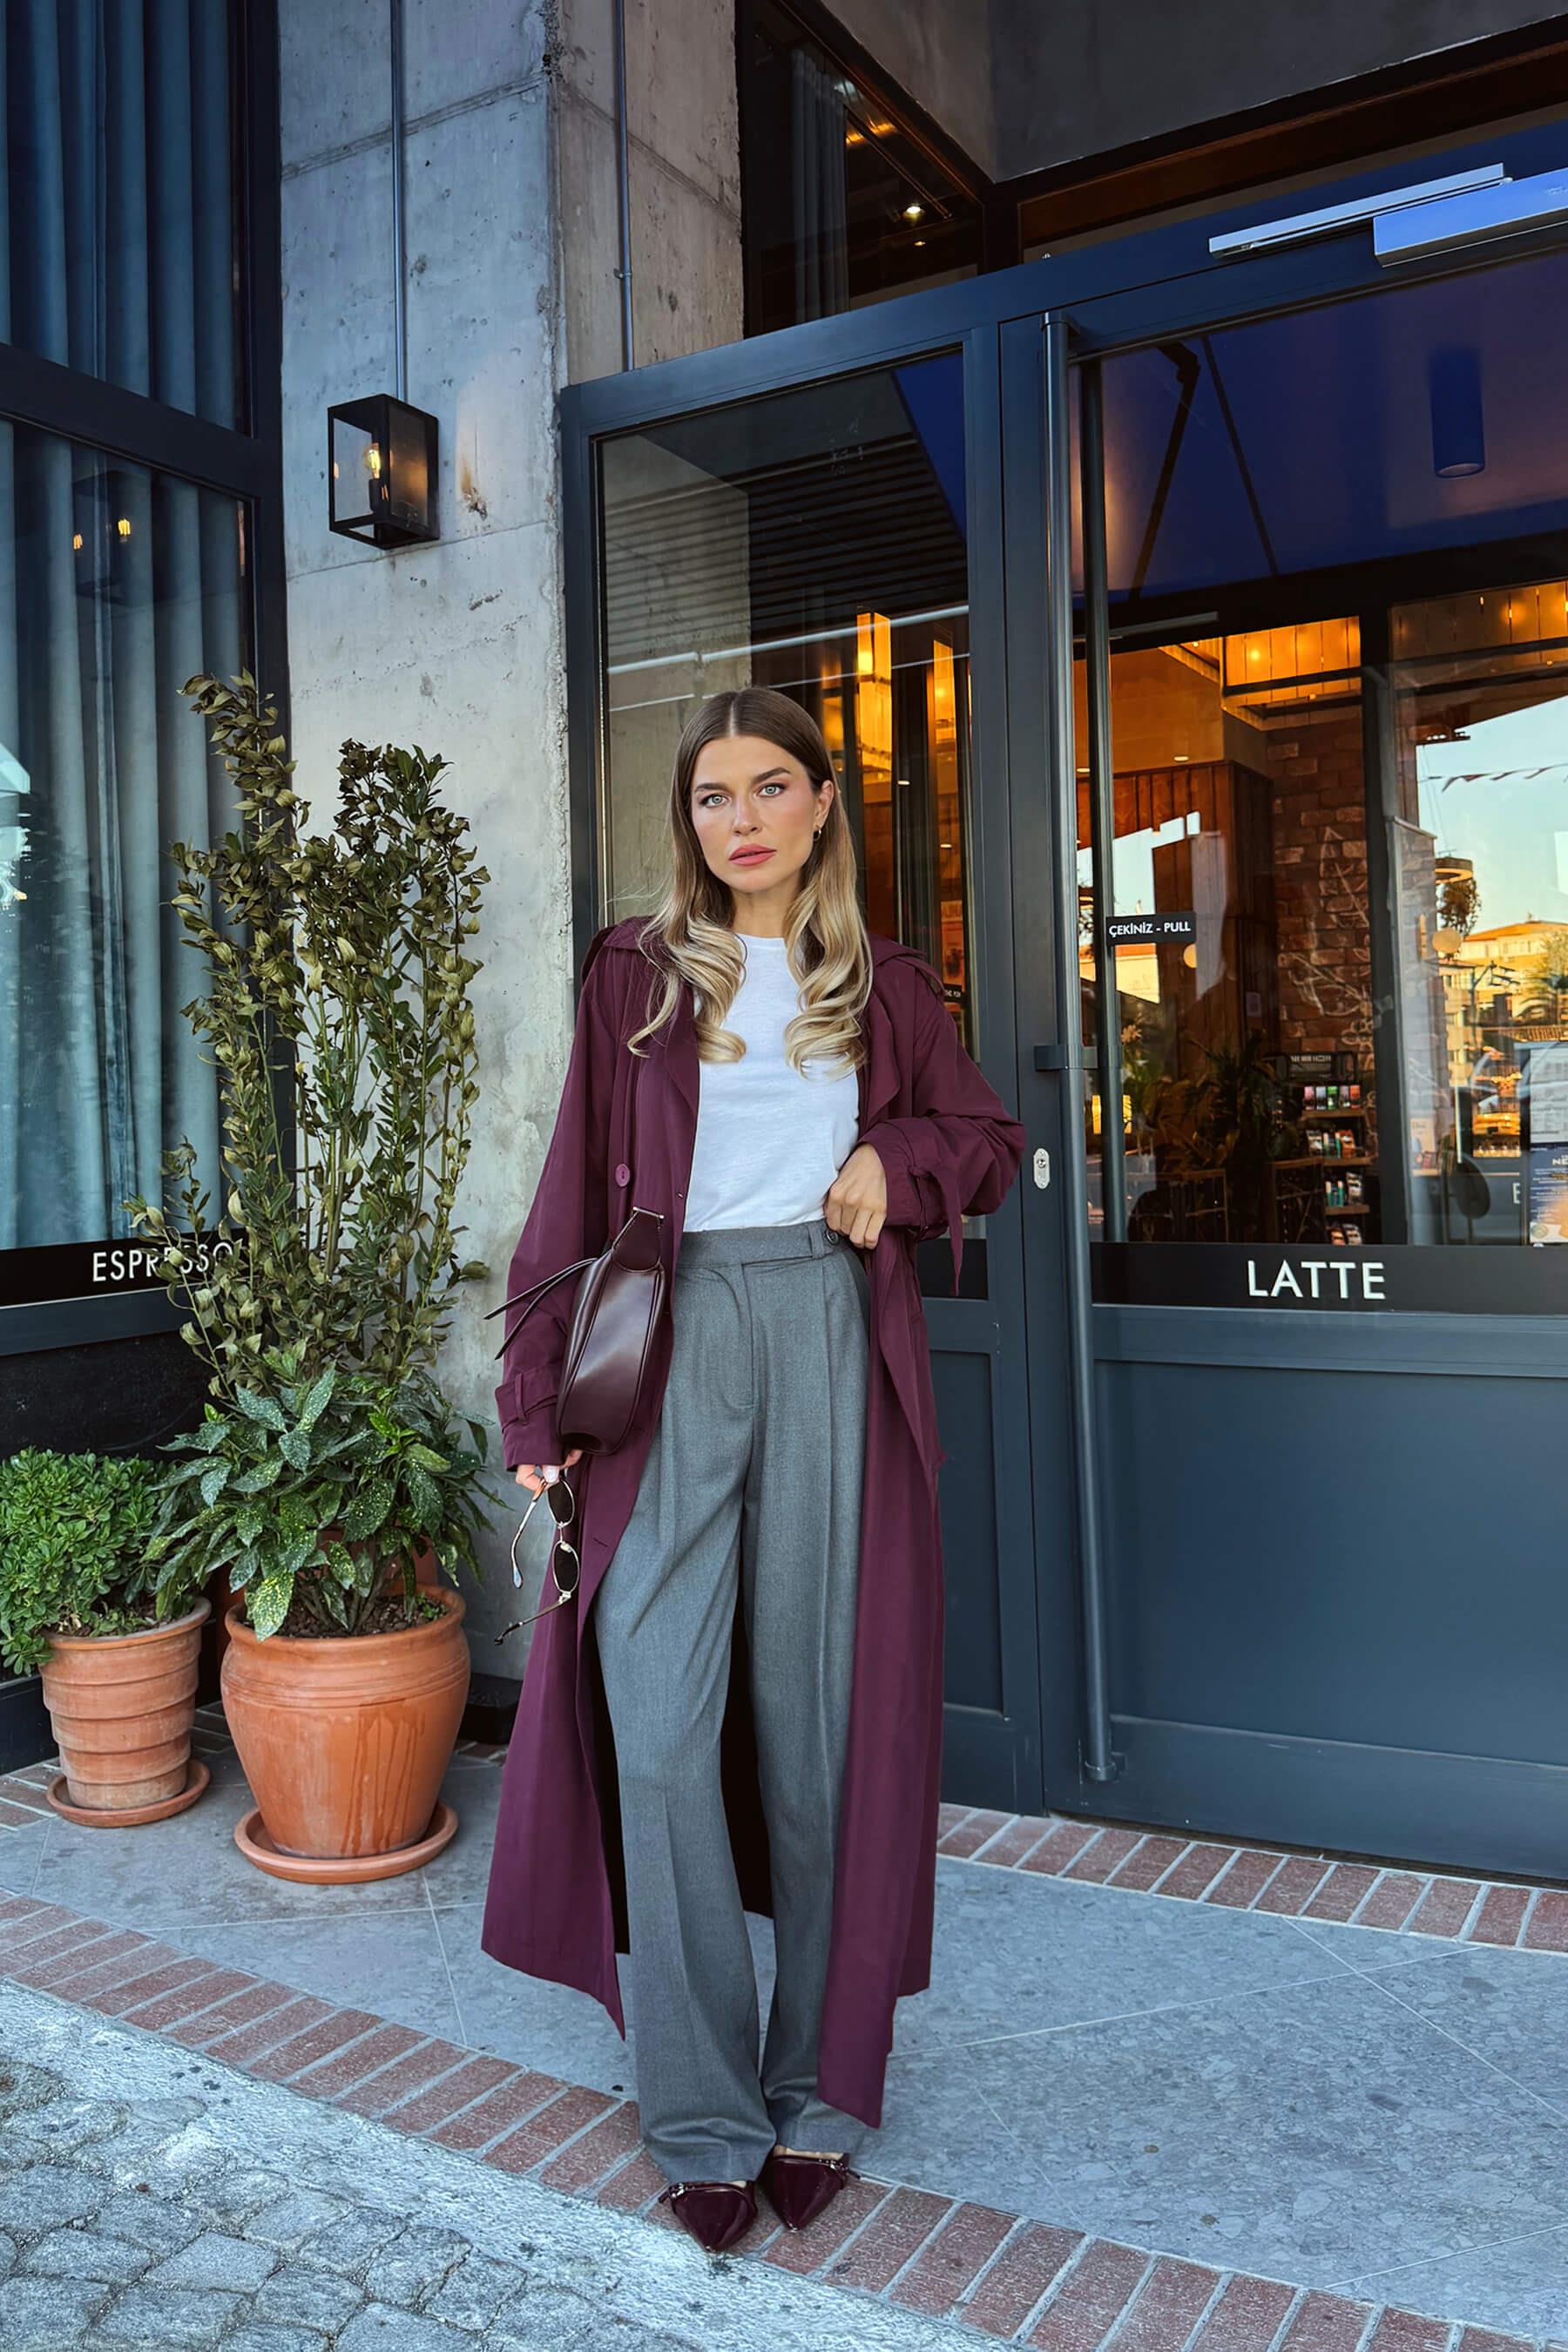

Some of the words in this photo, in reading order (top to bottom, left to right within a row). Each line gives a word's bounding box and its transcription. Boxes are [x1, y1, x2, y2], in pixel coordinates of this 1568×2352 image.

[1108, 922, 1153, 938] ÇEKİNİZ
[1164, 921, 1192, 933] PULL
[1247, 1259, 1386, 1300] LATTE
